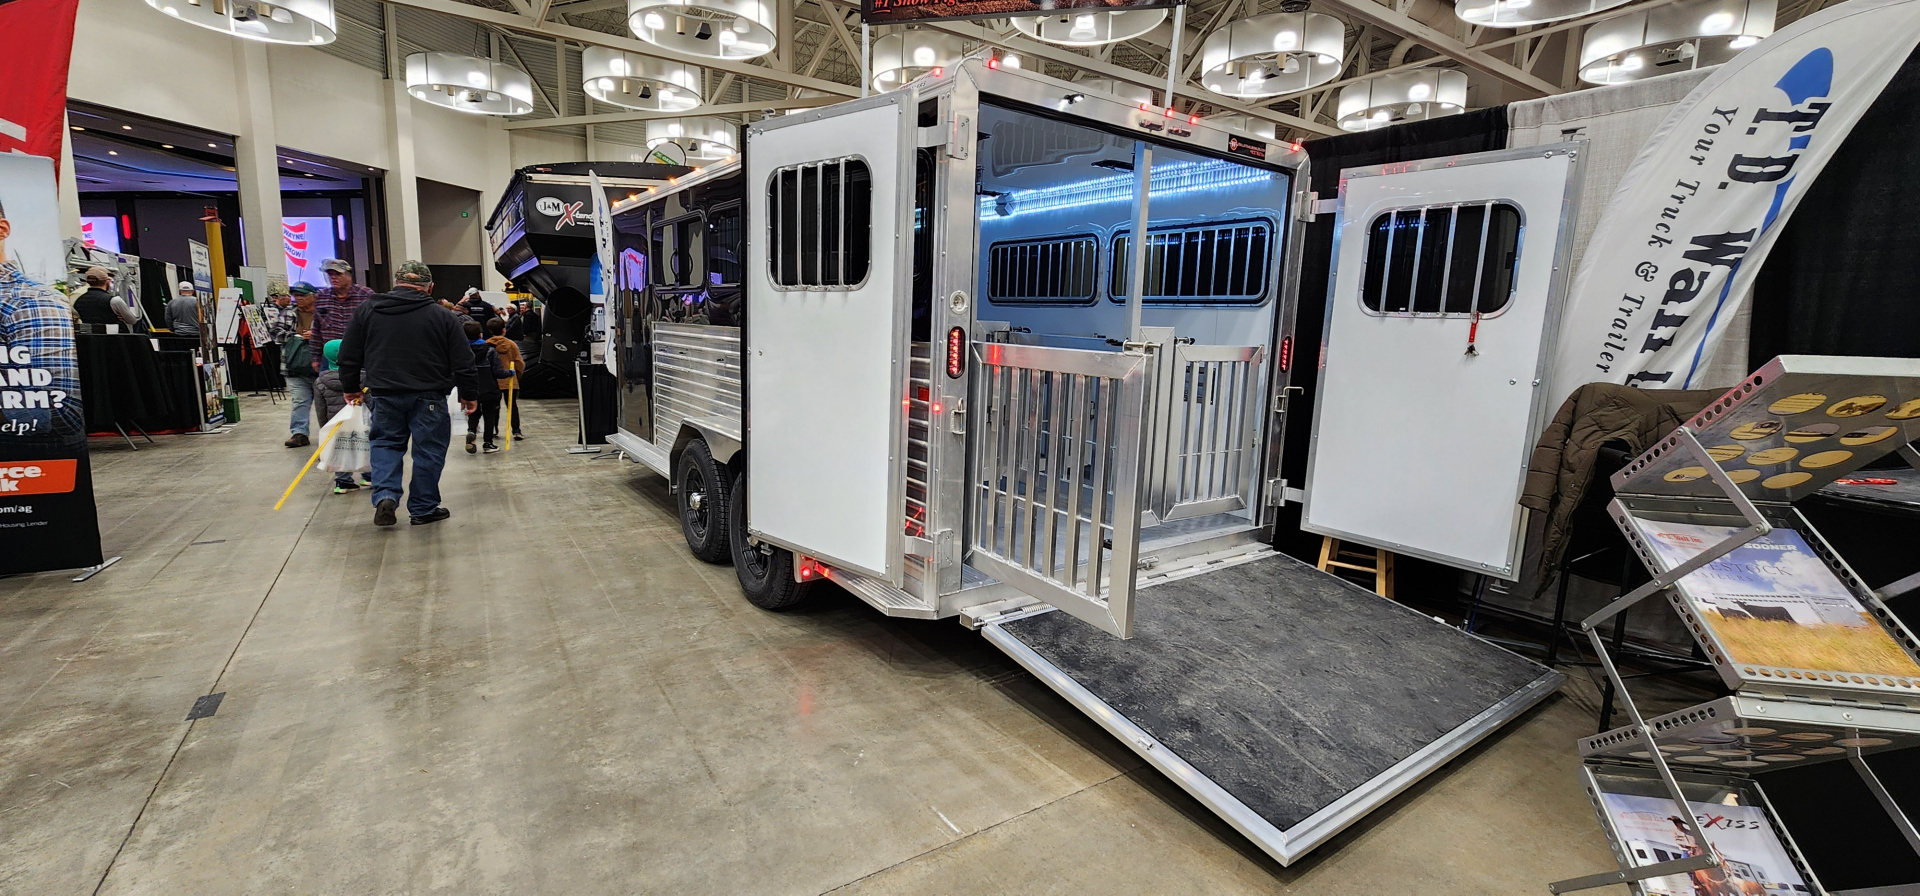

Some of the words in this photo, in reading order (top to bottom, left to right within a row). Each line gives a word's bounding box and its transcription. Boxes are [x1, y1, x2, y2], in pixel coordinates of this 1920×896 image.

[1690, 105, 1739, 166] Your
[1647, 178, 1700, 249] Truck
[283, 228, 304, 240] WAYNE
[284, 242, 301, 258] SHOW
[1634, 260, 1659, 282] &
[1594, 292, 1646, 374] Trailer
[0, 390, 67, 409] RM?
[1743, 543, 1798, 551] SOONER
